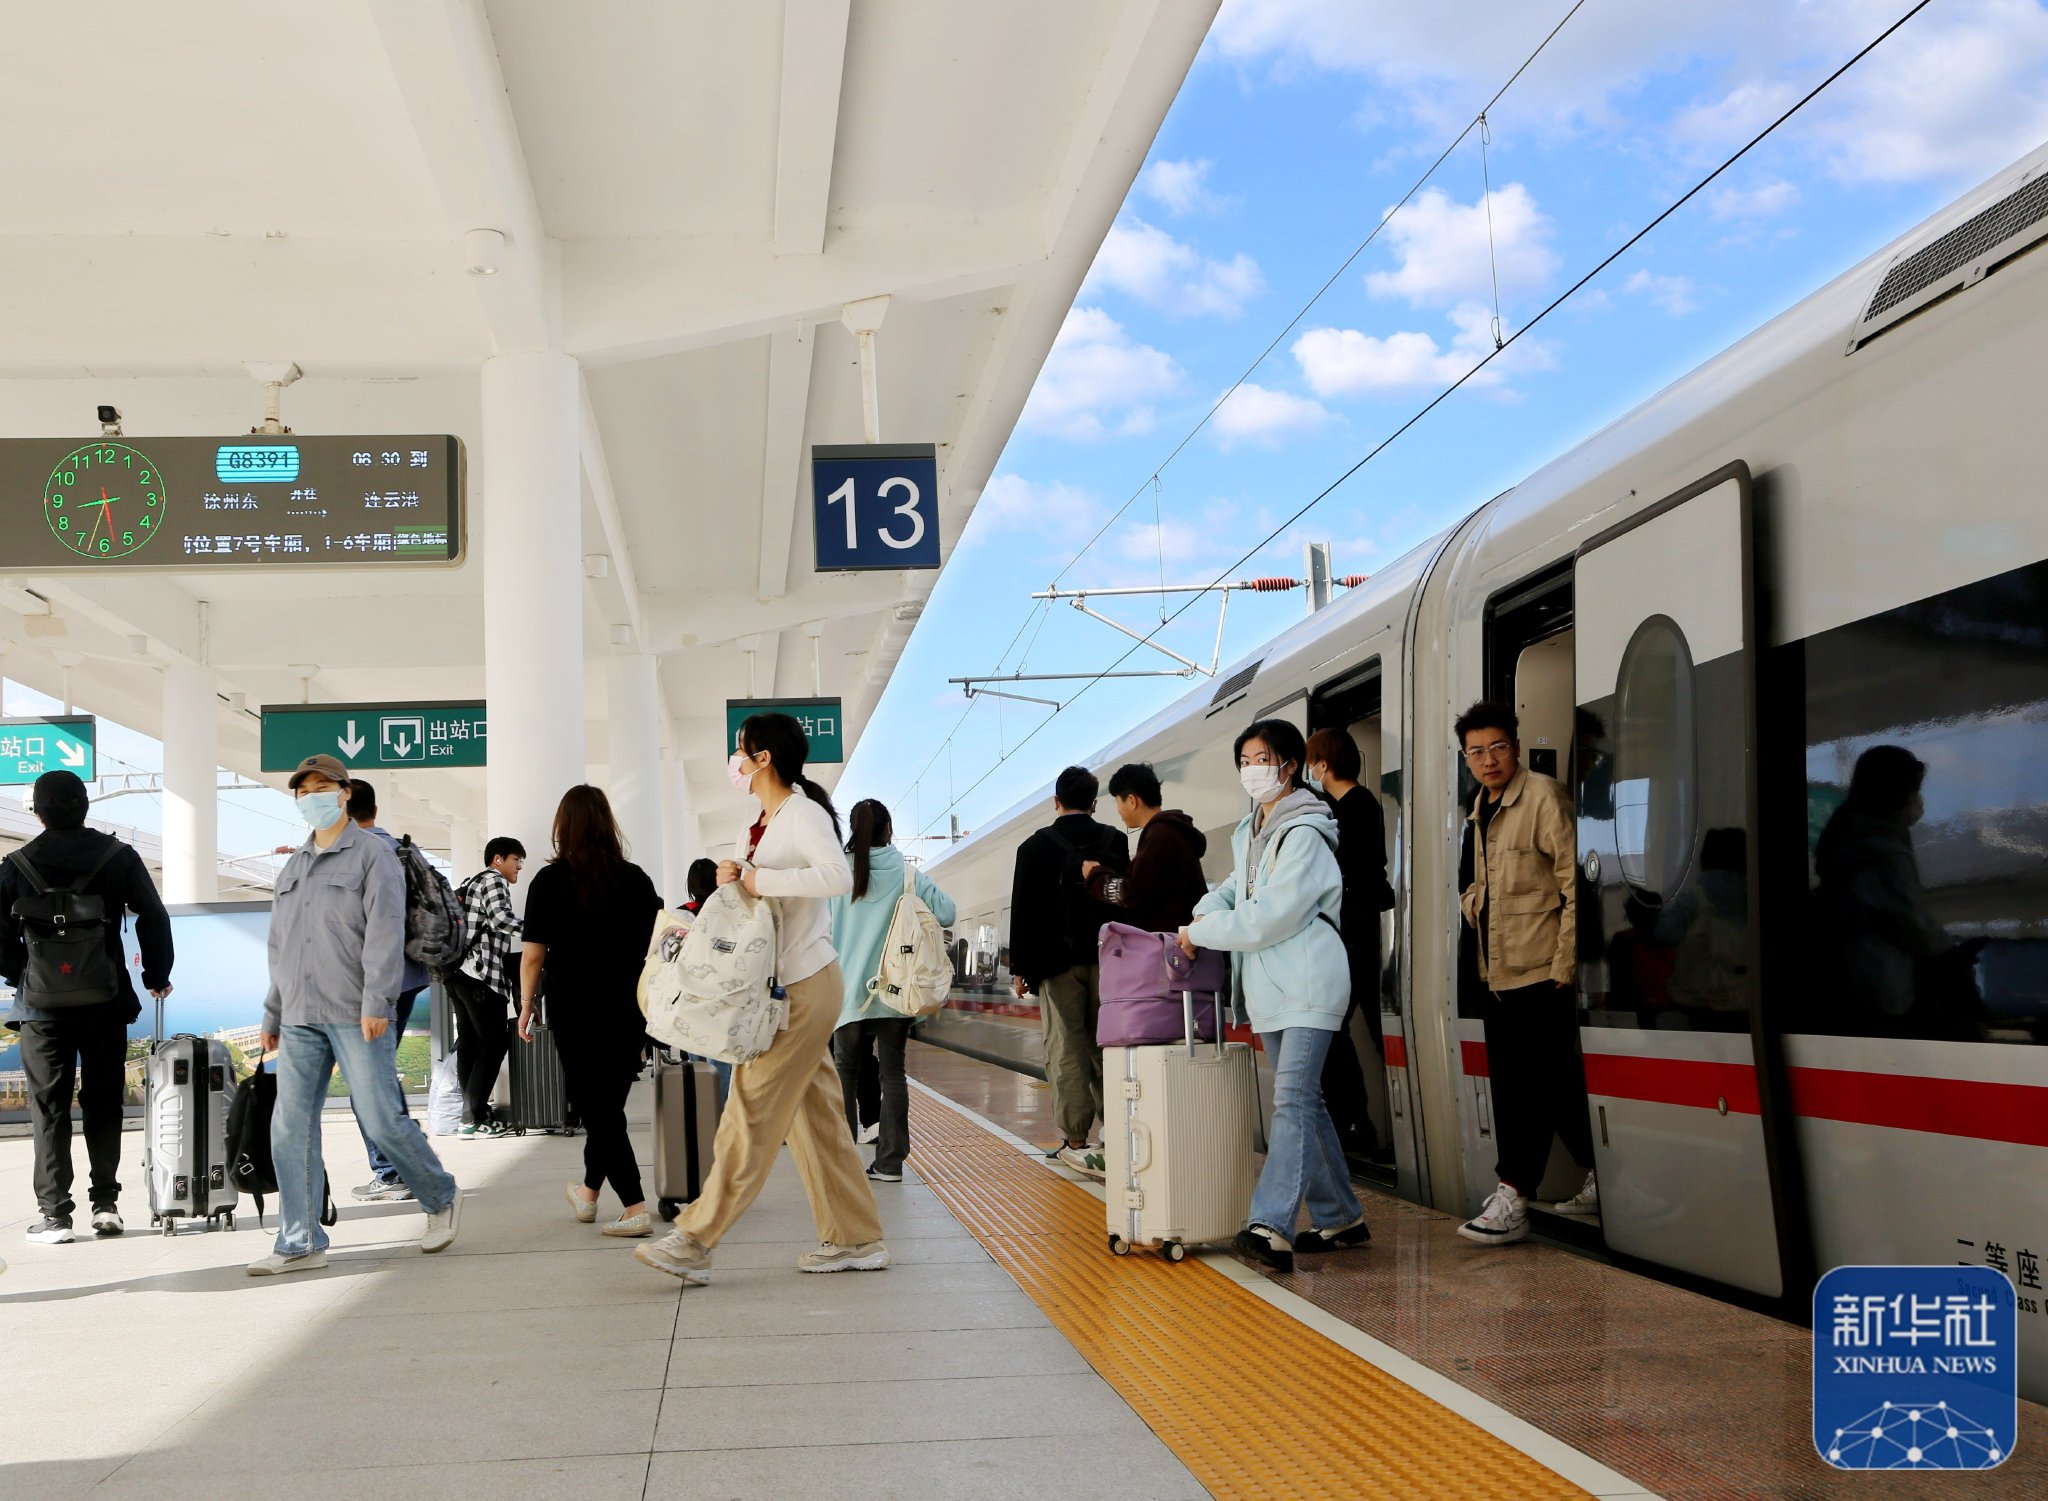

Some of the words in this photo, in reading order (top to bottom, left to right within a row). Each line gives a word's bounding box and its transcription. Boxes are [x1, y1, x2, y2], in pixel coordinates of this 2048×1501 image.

[72, 455, 89, 469] 11
[95, 449, 115, 464] 12
[124, 455, 131, 469] 1
[229, 451, 289, 469] G8391
[409, 450, 428, 468] 到
[54, 472, 75, 486] 10
[140, 470, 150, 485] 2
[52, 494, 63, 509] 9
[146, 492, 157, 507] 3
[203, 492, 258, 510] 徐州东
[364, 491, 419, 507] 连云港
[826, 476, 925, 550] 13
[58, 516, 69, 531] 8
[139, 514, 150, 529] 4
[75, 532, 86, 547] 7
[99, 538, 110, 553] 6
[123, 531, 133, 546] 5
[430, 719, 487, 741] 出站口
[0, 736, 45, 758] 站口
[430, 744, 454, 756] Exit
[18, 761, 45, 774] Exit
[1957, 1238, 2048, 1290] 二等座
